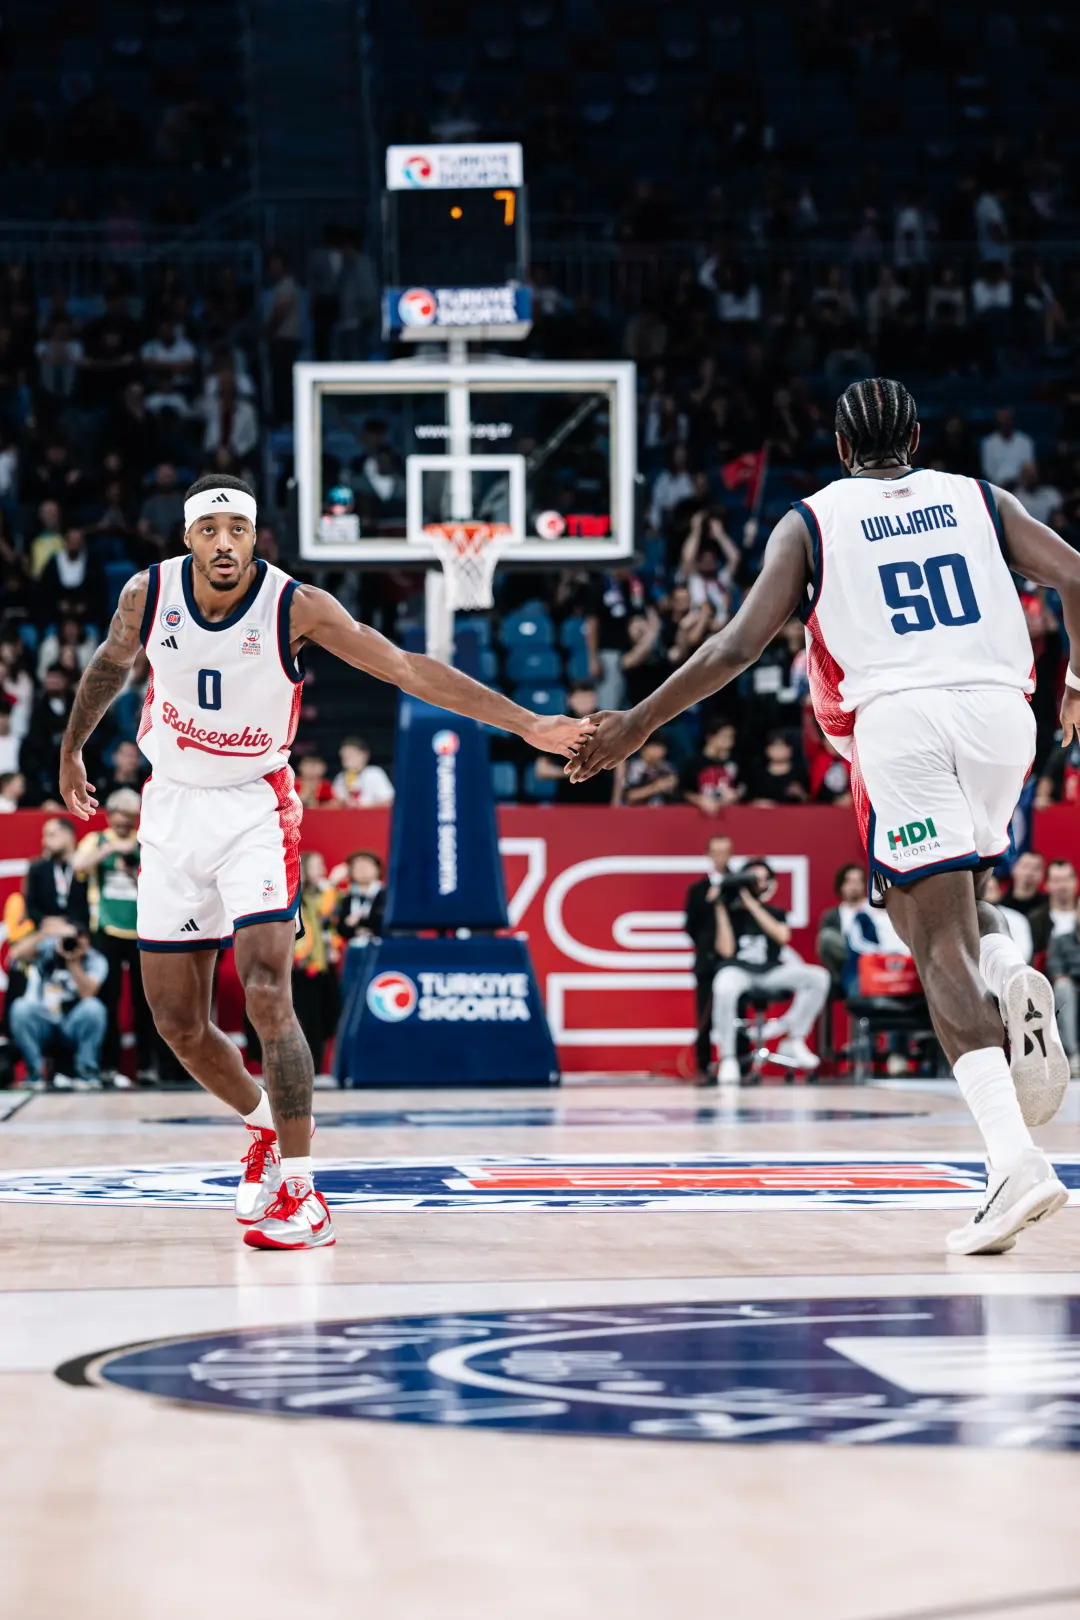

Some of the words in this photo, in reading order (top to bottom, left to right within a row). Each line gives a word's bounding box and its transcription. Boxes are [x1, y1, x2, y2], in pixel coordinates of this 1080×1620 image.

[493, 189, 516, 226] 7
[860, 504, 958, 542] WILLIAMS
[878, 553, 982, 636] 50
[198, 668, 222, 711] 0
[887, 817, 938, 851] HDI
